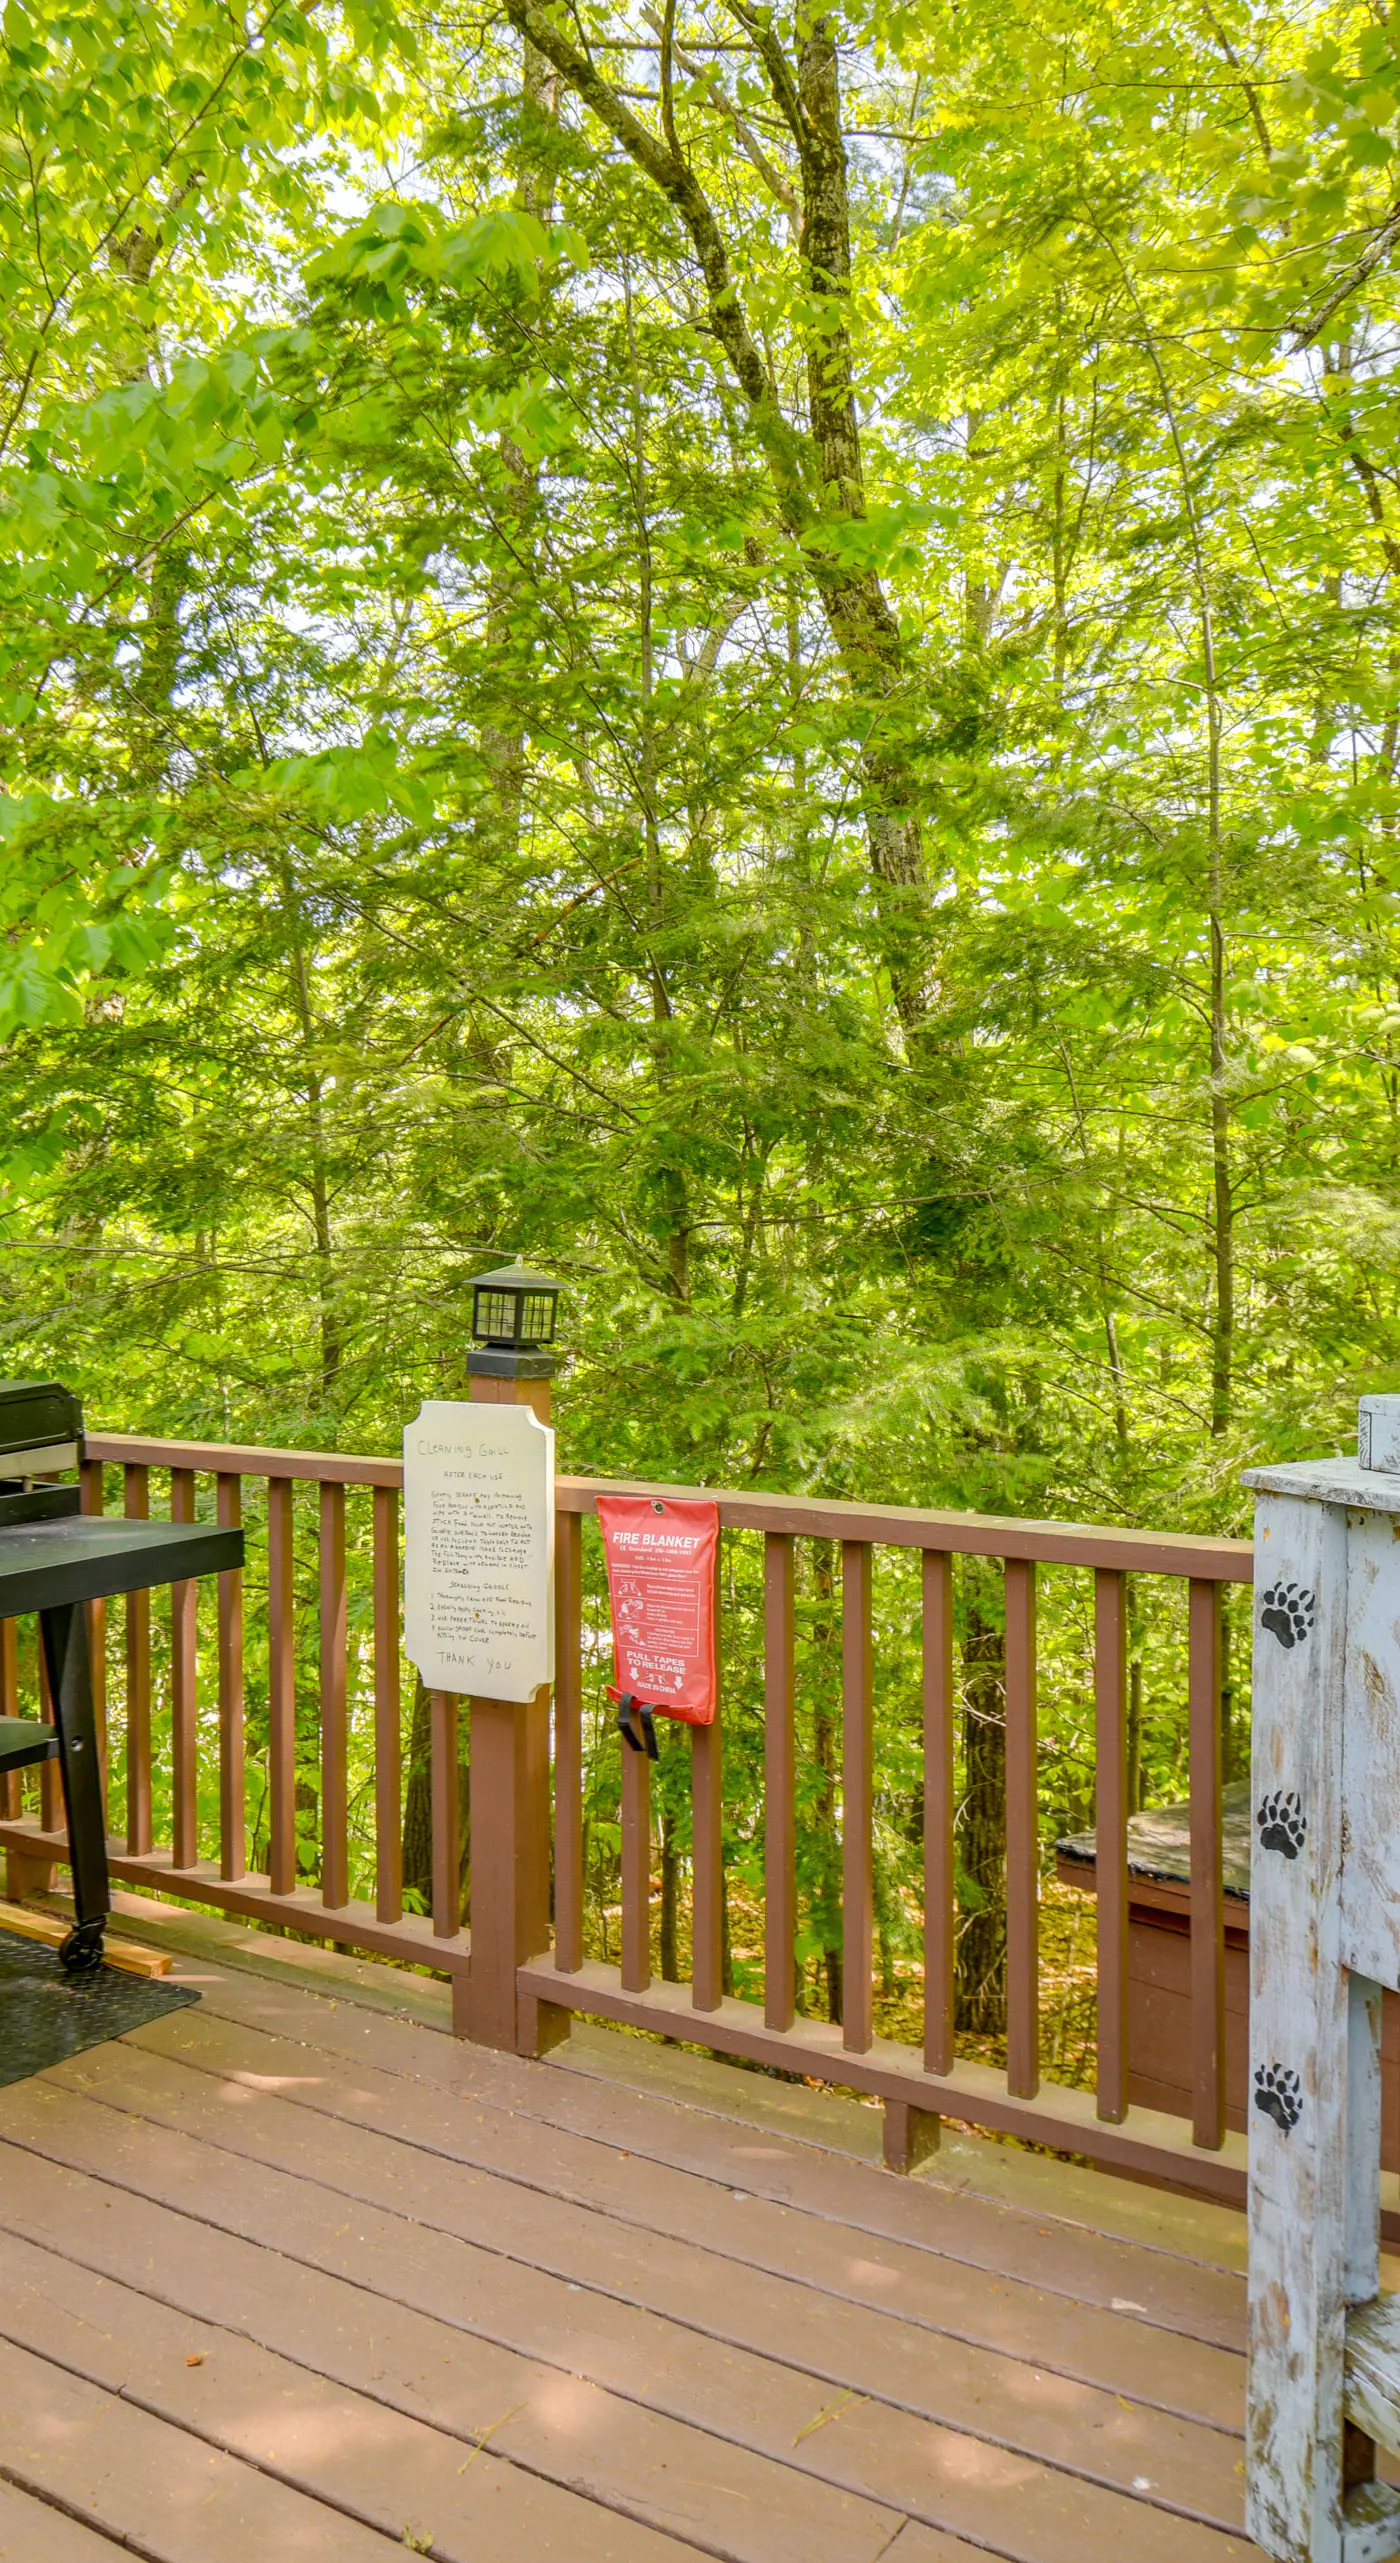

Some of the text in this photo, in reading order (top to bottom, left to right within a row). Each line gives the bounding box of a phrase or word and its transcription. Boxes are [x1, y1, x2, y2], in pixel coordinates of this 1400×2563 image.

[443, 1471, 466, 1479] AFTER
[489, 1473, 504, 1481] USE
[612, 1532, 700, 1549] FIRE BLANKET
[436, 1651, 476, 1666] THANK
[626, 1650, 685, 1667] PULL TAPES
[627, 1657, 687, 1675] TO RELEASE
[637, 1681, 653, 1690] MADE
[659, 1684, 677, 1695] CHINA
